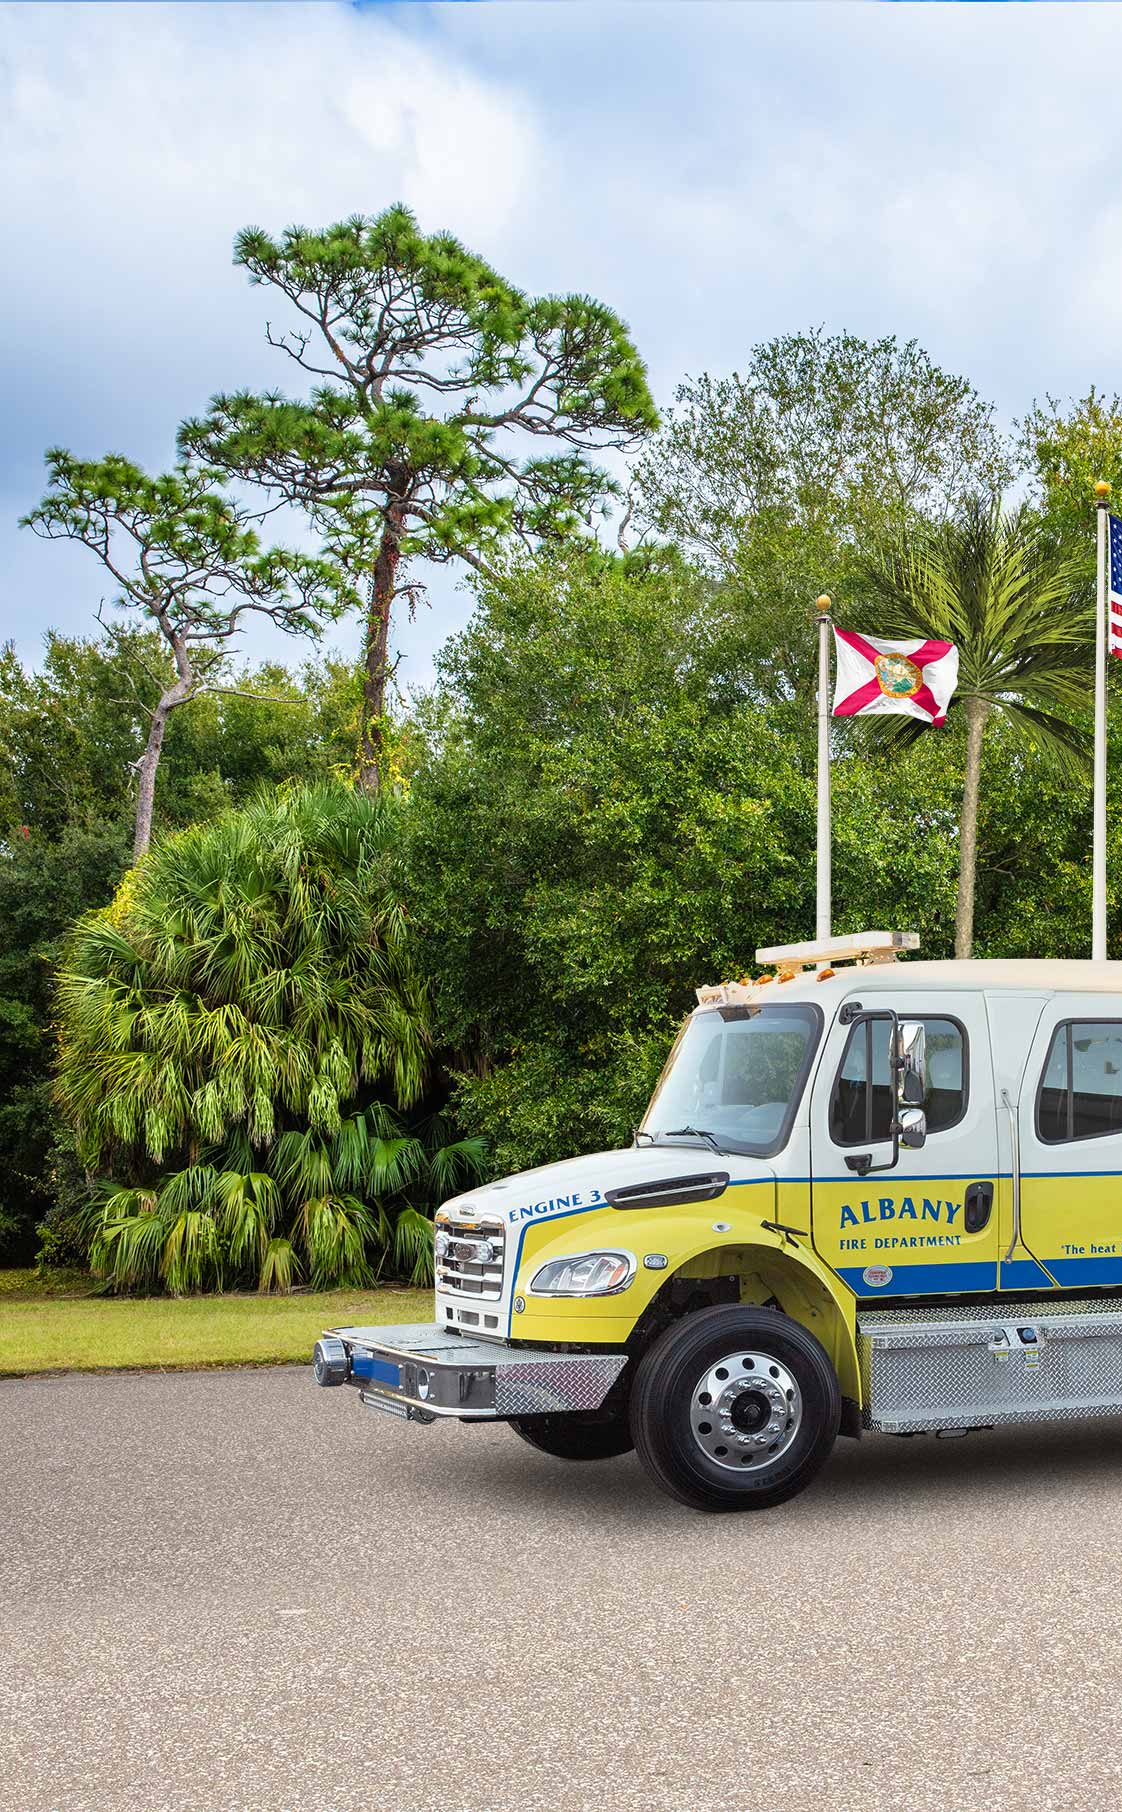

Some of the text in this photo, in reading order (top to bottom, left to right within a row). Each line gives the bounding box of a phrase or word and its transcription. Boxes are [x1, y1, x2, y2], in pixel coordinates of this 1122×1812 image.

[509, 1190, 601, 1223] ENGINE 3
[839, 1197, 961, 1229] ALBANY
[839, 1235, 961, 1250] FIRE DEPARTMENT
[1090, 1243, 1116, 1254] heat
